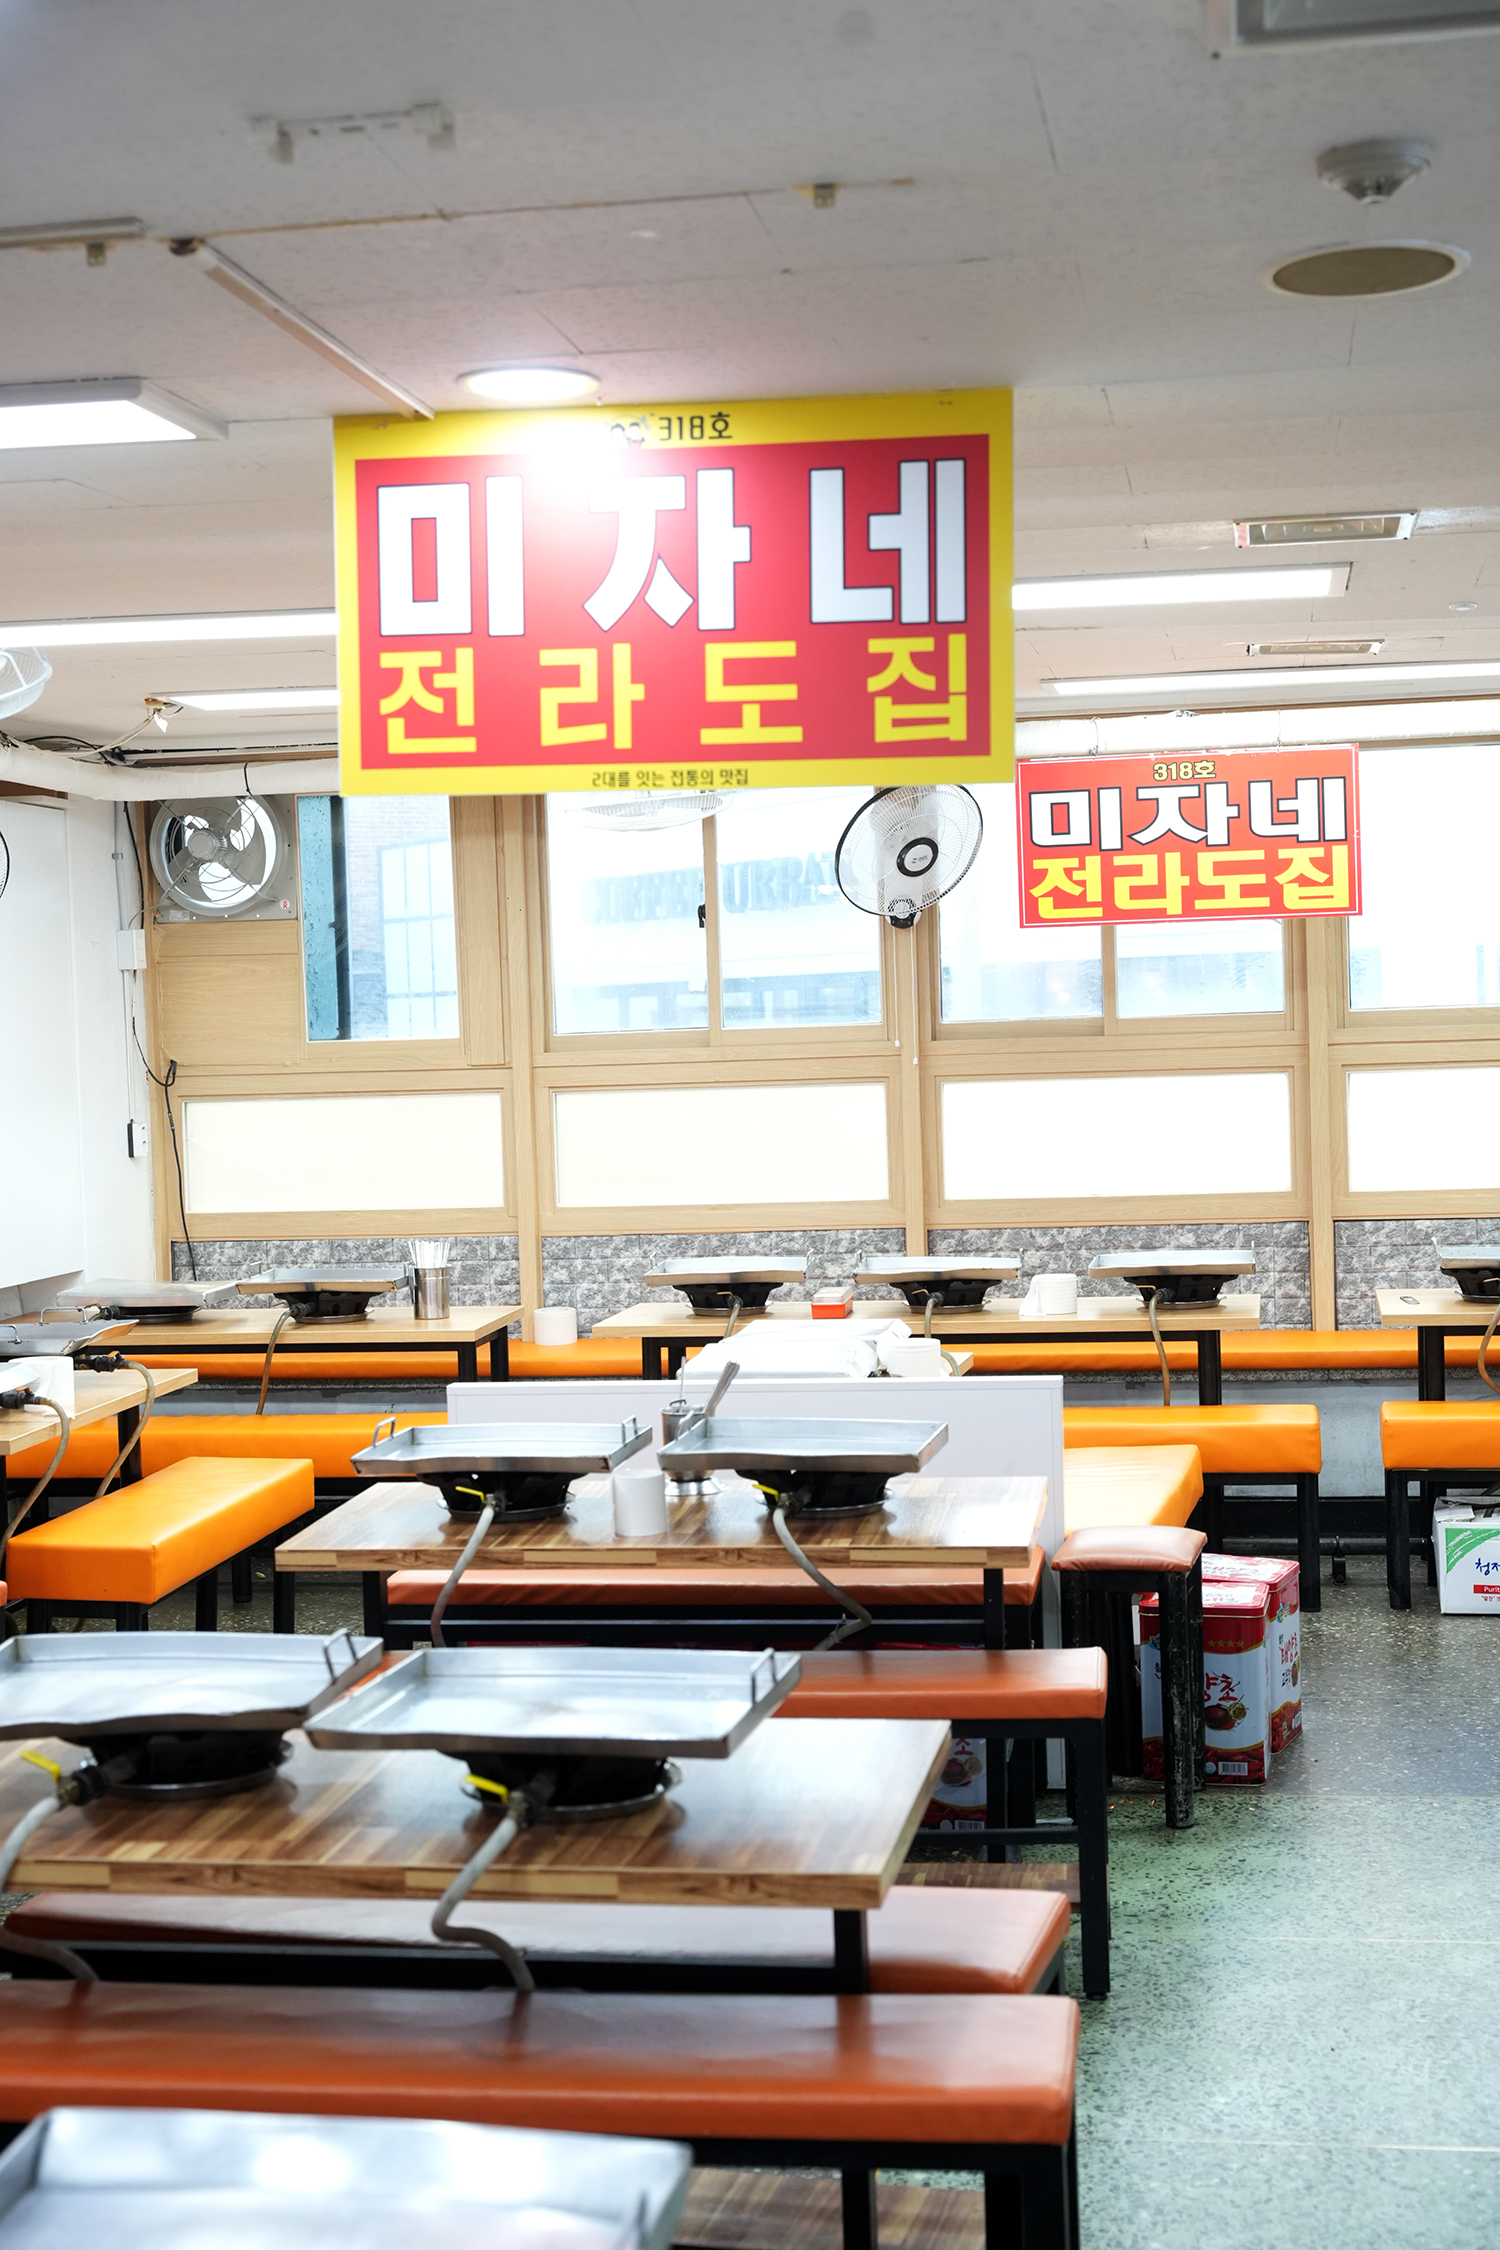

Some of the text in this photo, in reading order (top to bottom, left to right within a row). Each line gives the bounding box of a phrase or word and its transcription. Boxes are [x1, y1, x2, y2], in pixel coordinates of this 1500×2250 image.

[658, 411, 733, 442] 318호
[636, 770, 665, 788] 잇는
[670, 768, 714, 787] 전통의
[720, 768, 749, 786] 맛집
[1153, 760, 1217, 782] 318호
[1028, 776, 1348, 852] 미자네
[1029, 844, 1350, 919] 전라도집
